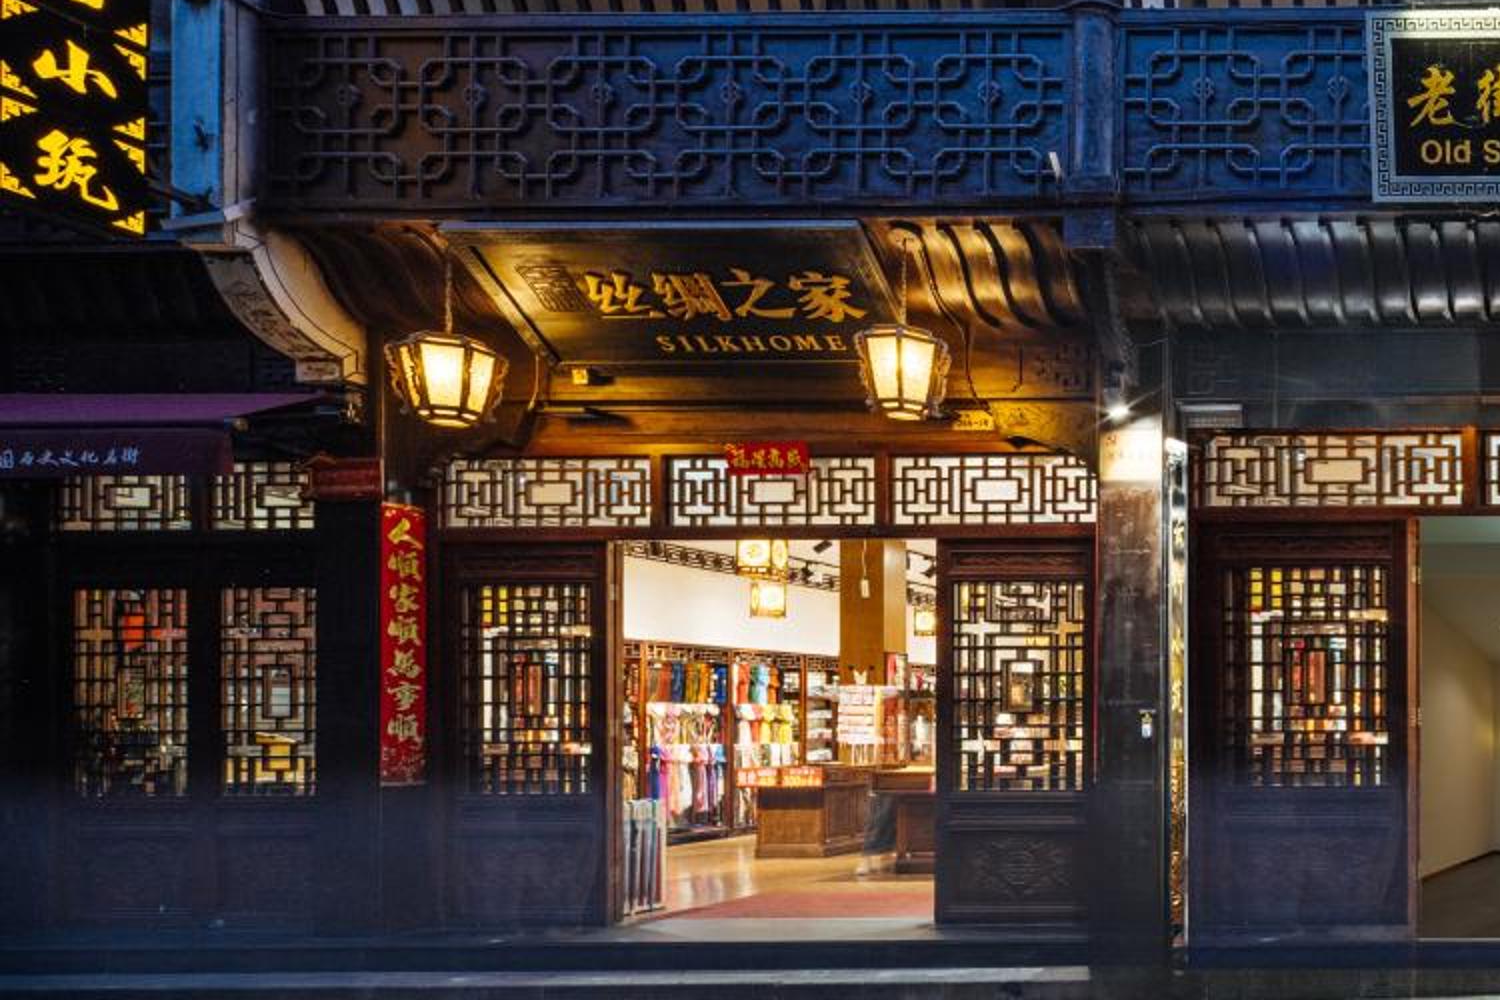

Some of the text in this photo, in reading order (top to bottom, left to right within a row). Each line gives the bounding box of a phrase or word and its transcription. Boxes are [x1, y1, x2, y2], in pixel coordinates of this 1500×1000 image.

[1420, 138, 1471, 164] Old
[583, 266, 866, 323] 丝绸之家
[655, 333, 848, 353] SILKHOME
